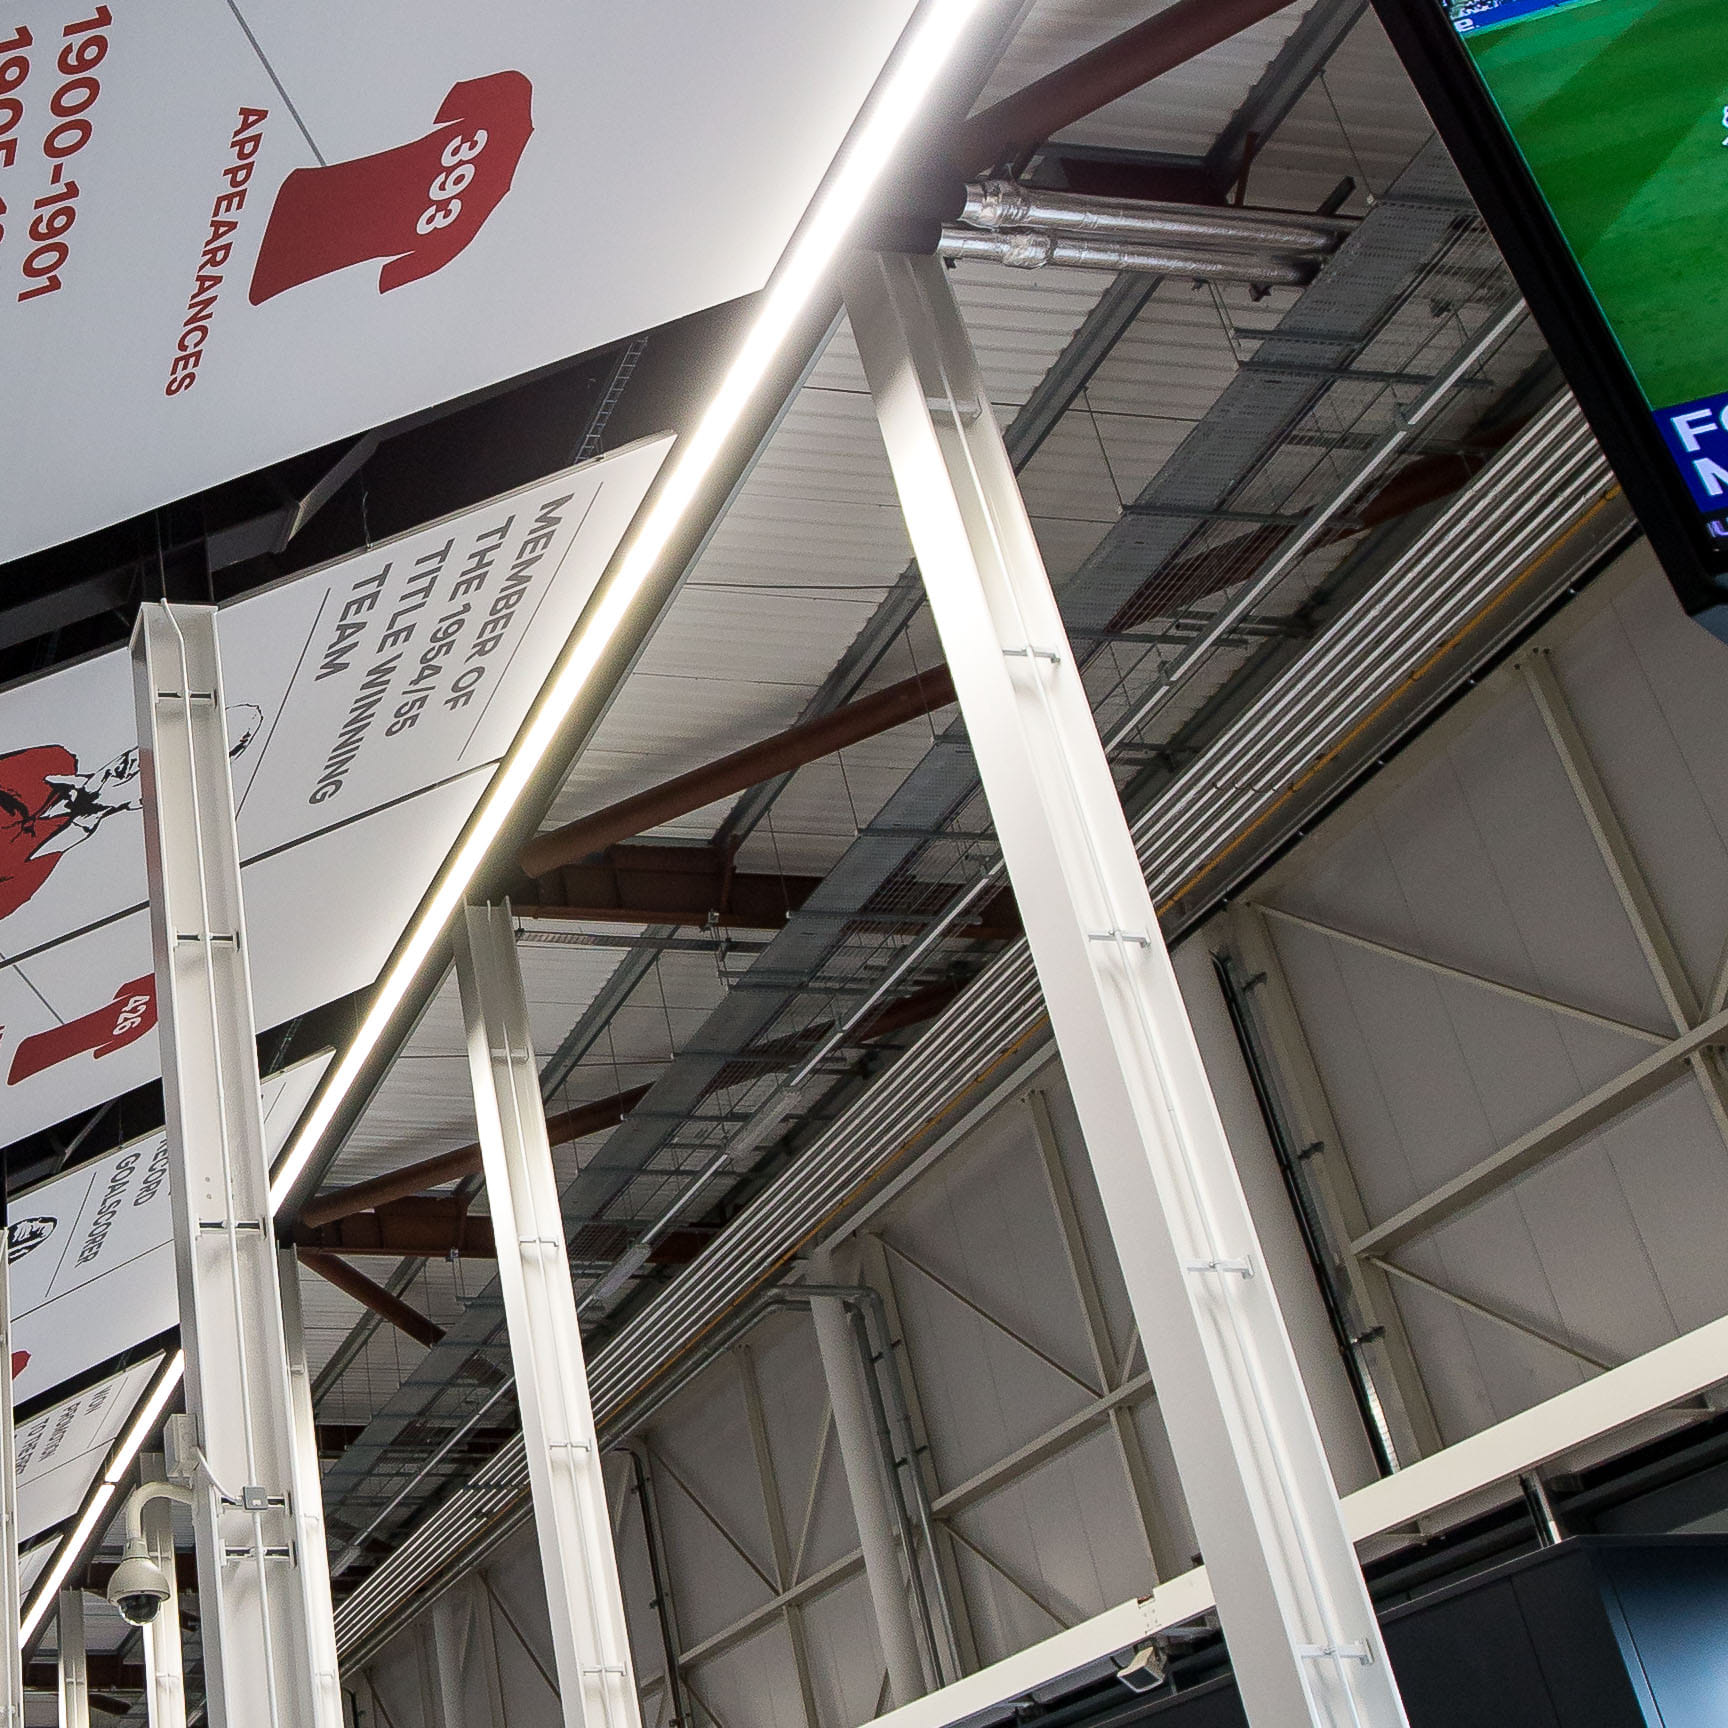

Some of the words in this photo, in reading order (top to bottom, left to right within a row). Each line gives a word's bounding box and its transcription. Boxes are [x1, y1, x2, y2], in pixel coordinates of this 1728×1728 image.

[18, 4, 114, 303] 1900-1901
[416, 128, 489, 236] 393
[165, 105, 270, 398] APPEARANCES
[376, 538, 455, 655] TITLE
[449, 514, 516, 603] THE
[472, 492, 575, 660] MEMBER
[314, 562, 394, 683] TEAM
[384, 602, 472, 738] 1954/55
[308, 651, 403, 805] WINNING
[443, 666, 486, 712] OF
[112, 994, 151, 1035] 426
[75, 1152, 141, 1269] GOALSCORER
